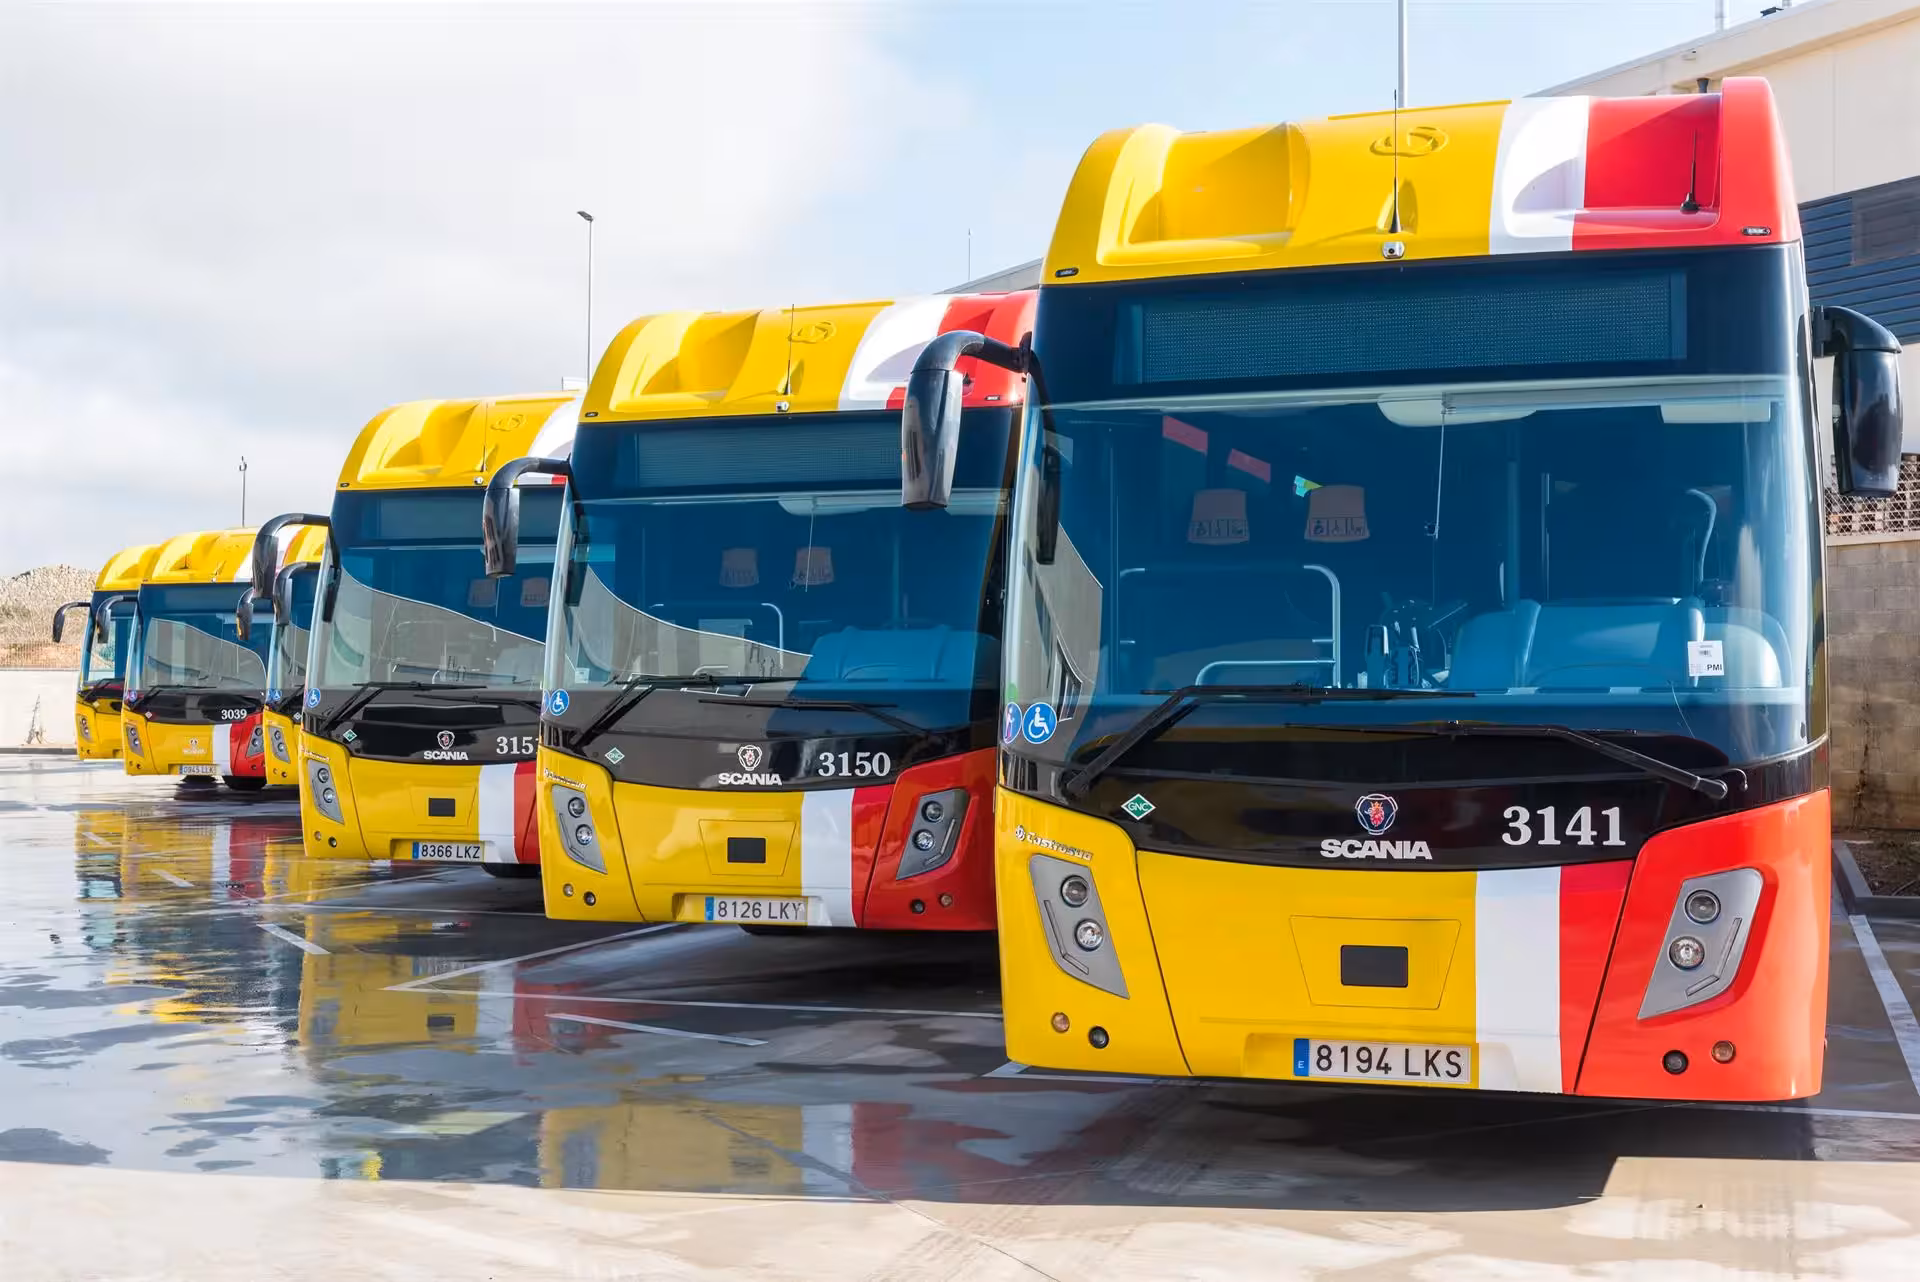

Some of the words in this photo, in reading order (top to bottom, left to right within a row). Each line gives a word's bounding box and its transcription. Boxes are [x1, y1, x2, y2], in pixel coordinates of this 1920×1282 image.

[221, 709, 247, 720] 3039
[496, 736, 538, 754] 315
[423, 750, 468, 760] SCANIA
[818, 752, 891, 776] 3150
[718, 772, 782, 786] SCANIA
[1127, 802, 1149, 812] GNC
[1501, 805, 1626, 845] 3141
[421, 844, 452, 858] 8366
[456, 845, 480, 859] LKZ
[1320, 838, 1433, 860] SCANIA
[718, 900, 762, 919] 8126
[768, 901, 802, 920] LKY
[1298, 1060, 1304, 1069] E
[1316, 1044, 1392, 1075] 8194
[1404, 1048, 1462, 1078] LKS
